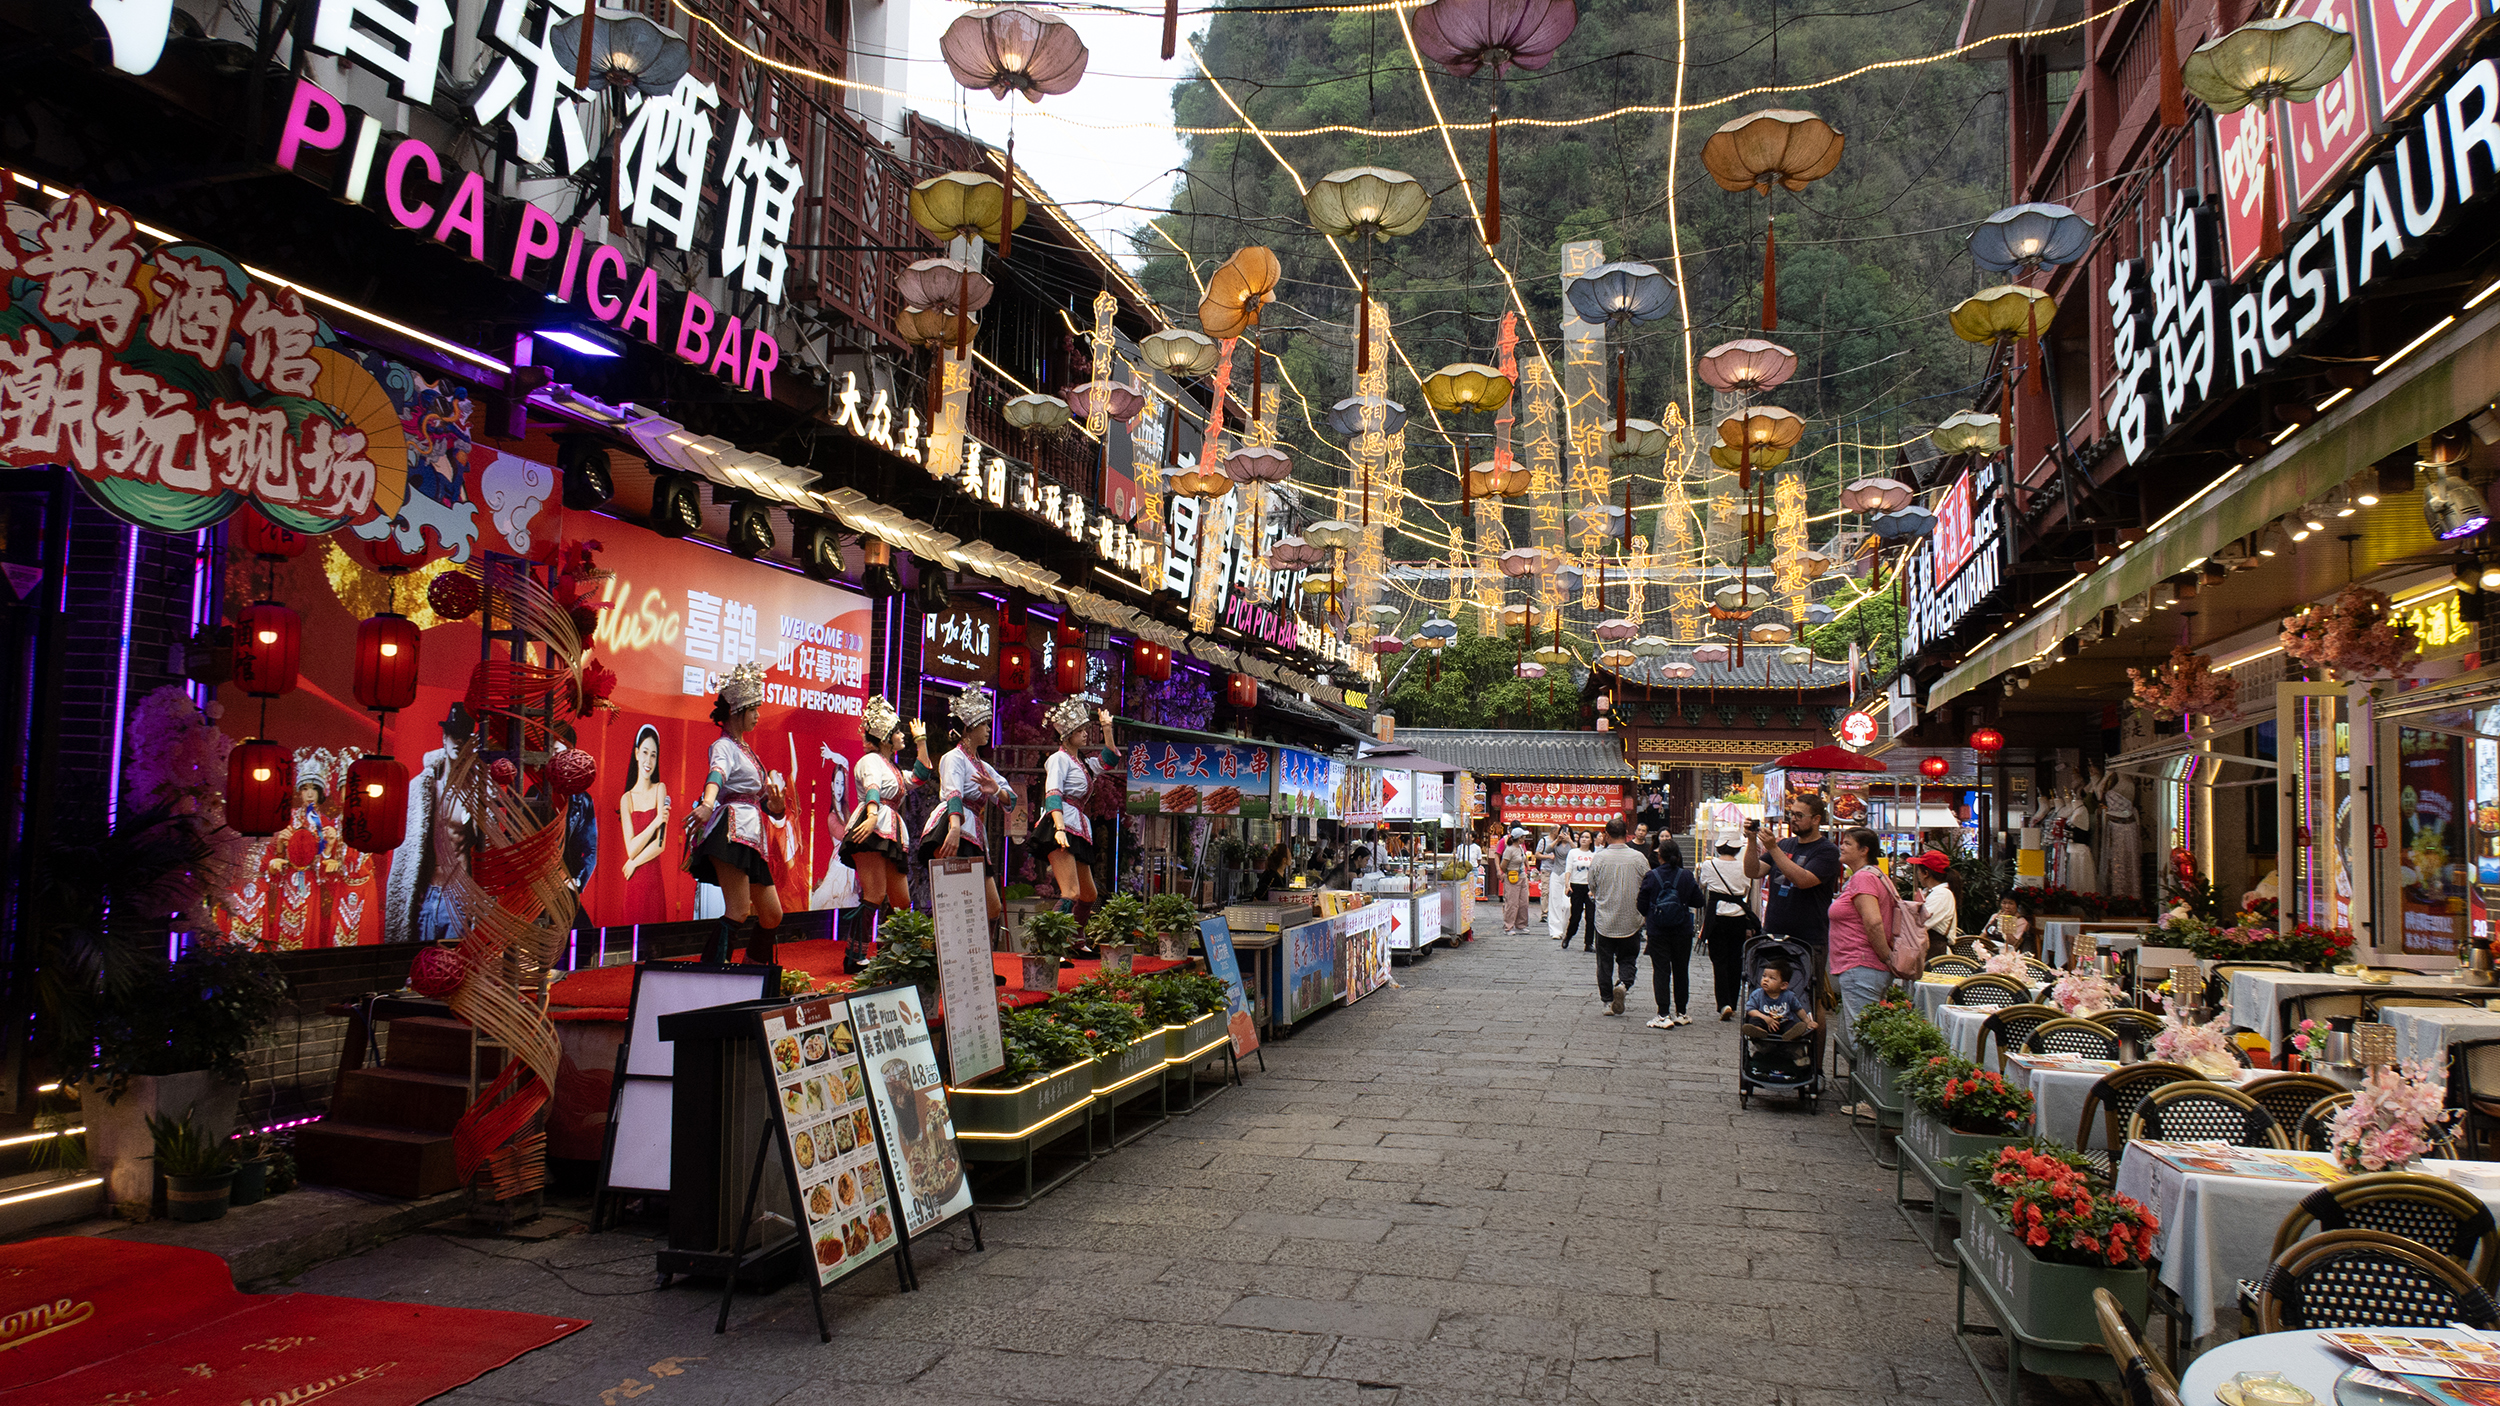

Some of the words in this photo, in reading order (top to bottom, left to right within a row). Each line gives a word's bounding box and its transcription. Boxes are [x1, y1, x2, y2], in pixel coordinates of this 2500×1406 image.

[276, 78, 485, 262] PICA
[510, 202, 658, 345] PICA
[675, 291, 779, 400] BAR
[0, 192, 320, 398] 鹊酒馆
[2107, 188, 2214, 466] 喜鹊
[837, 370, 932, 465] 大众点
[1936, 537, 2000, 637] RESTAURANT
[780, 614, 843, 649] WELCOME
[1225, 594, 1252, 634] PICA
[1252, 602, 1279, 644] PICA
[1277, 617, 1299, 651] BAR
[799, 645, 863, 690] 好事来到
[767, 683, 798, 708] STAR
[800, 689, 863, 717] PERFORMER
[1128, 743, 1271, 783] 蒙古大肉串
[879, 1009, 898, 1025] Pizza
[863, 1025, 907, 1059] 美式咖啡
[911, 1063, 927, 1087] 48
[877, 1098, 906, 1194] AMERICANO
[0, 1298, 95, 1340] ome
